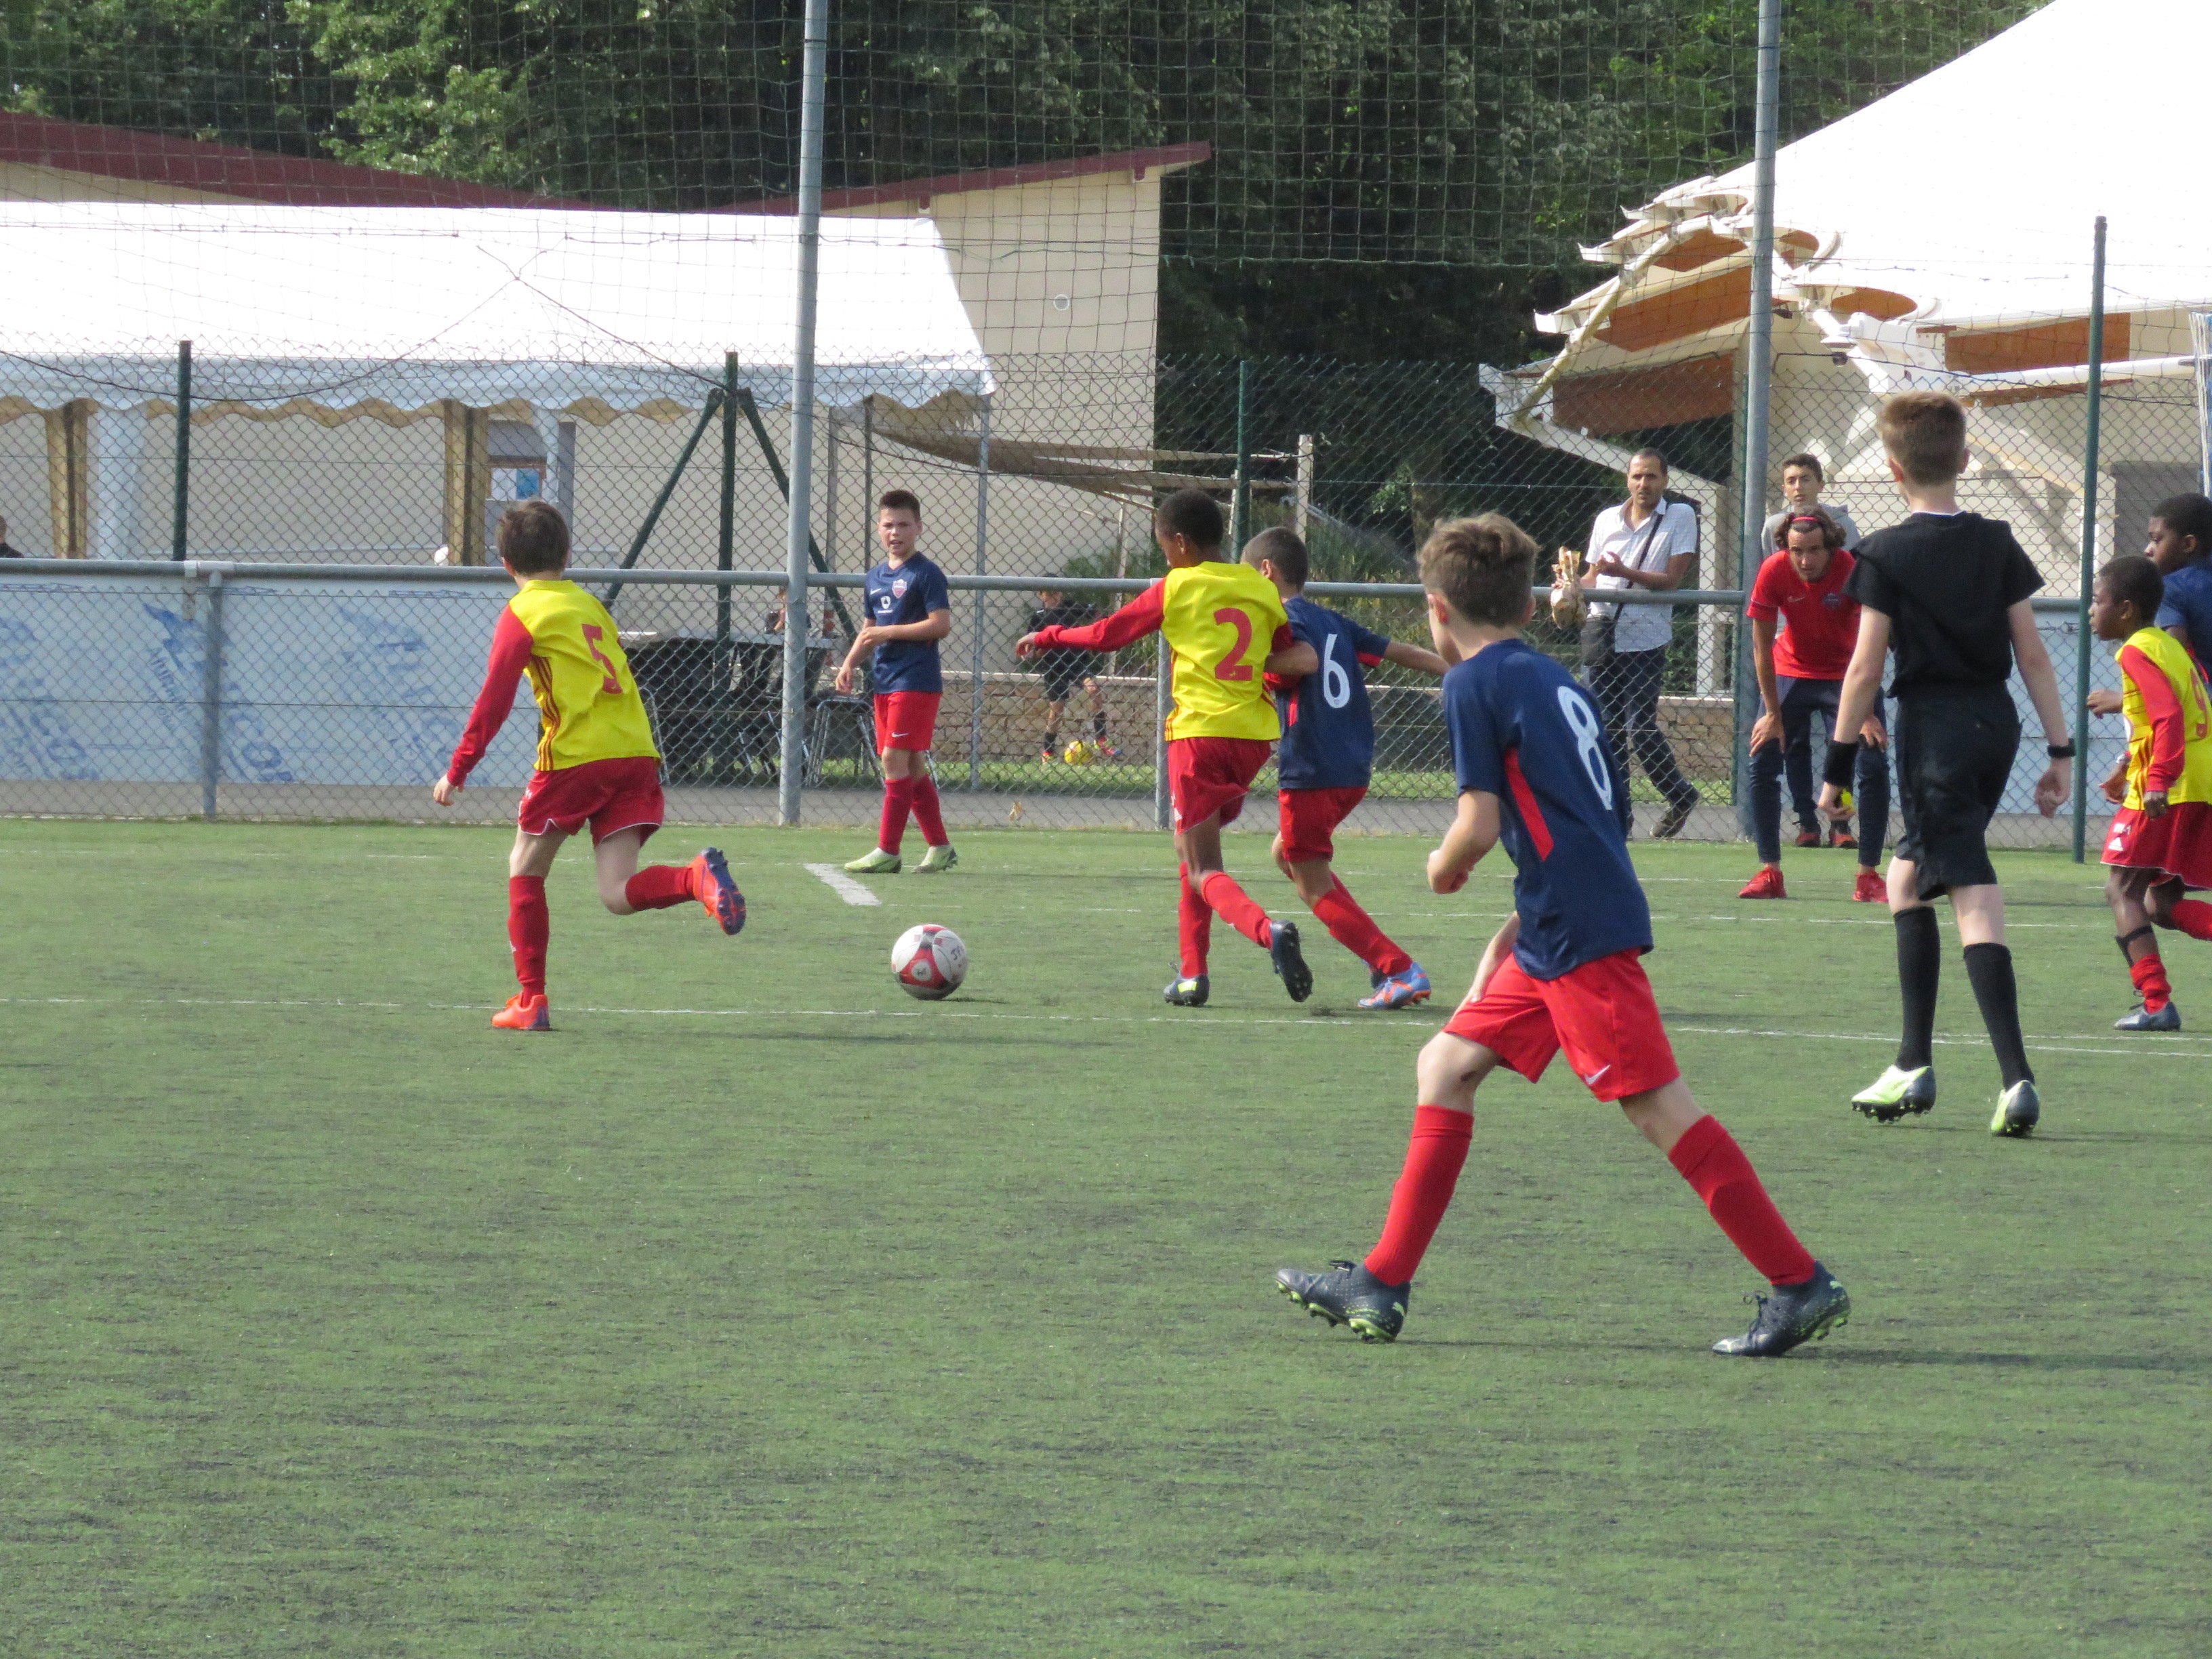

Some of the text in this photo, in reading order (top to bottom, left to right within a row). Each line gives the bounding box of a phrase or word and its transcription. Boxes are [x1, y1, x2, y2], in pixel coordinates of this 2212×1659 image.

[581, 623, 623, 695] 5
[1213, 607, 1253, 682] 2
[1323, 633, 1351, 709] 6
[1557, 686, 1613, 811] 8
